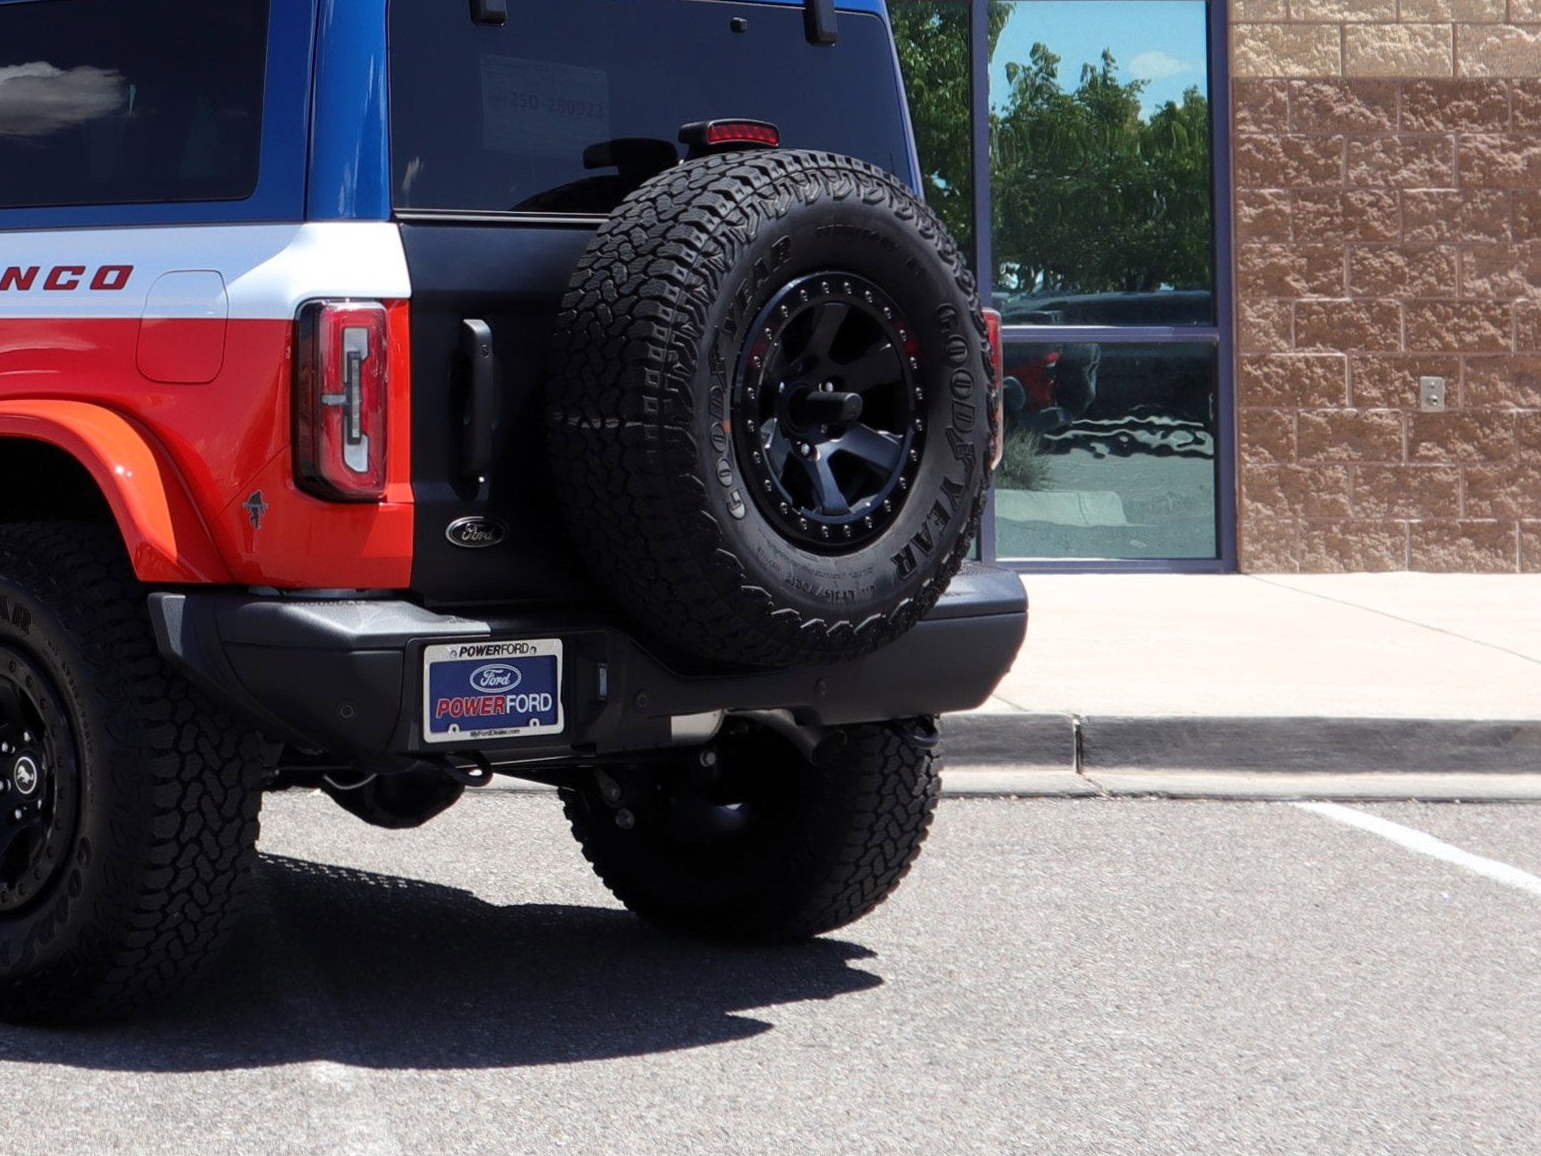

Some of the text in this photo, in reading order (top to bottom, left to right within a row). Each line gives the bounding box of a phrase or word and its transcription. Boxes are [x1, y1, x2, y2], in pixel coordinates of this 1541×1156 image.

[462, 523, 495, 541] Ford
[460, 643, 529, 657] POWERFORD
[480, 670, 511, 686] Ford
[436, 693, 552, 719] POWERFORD
